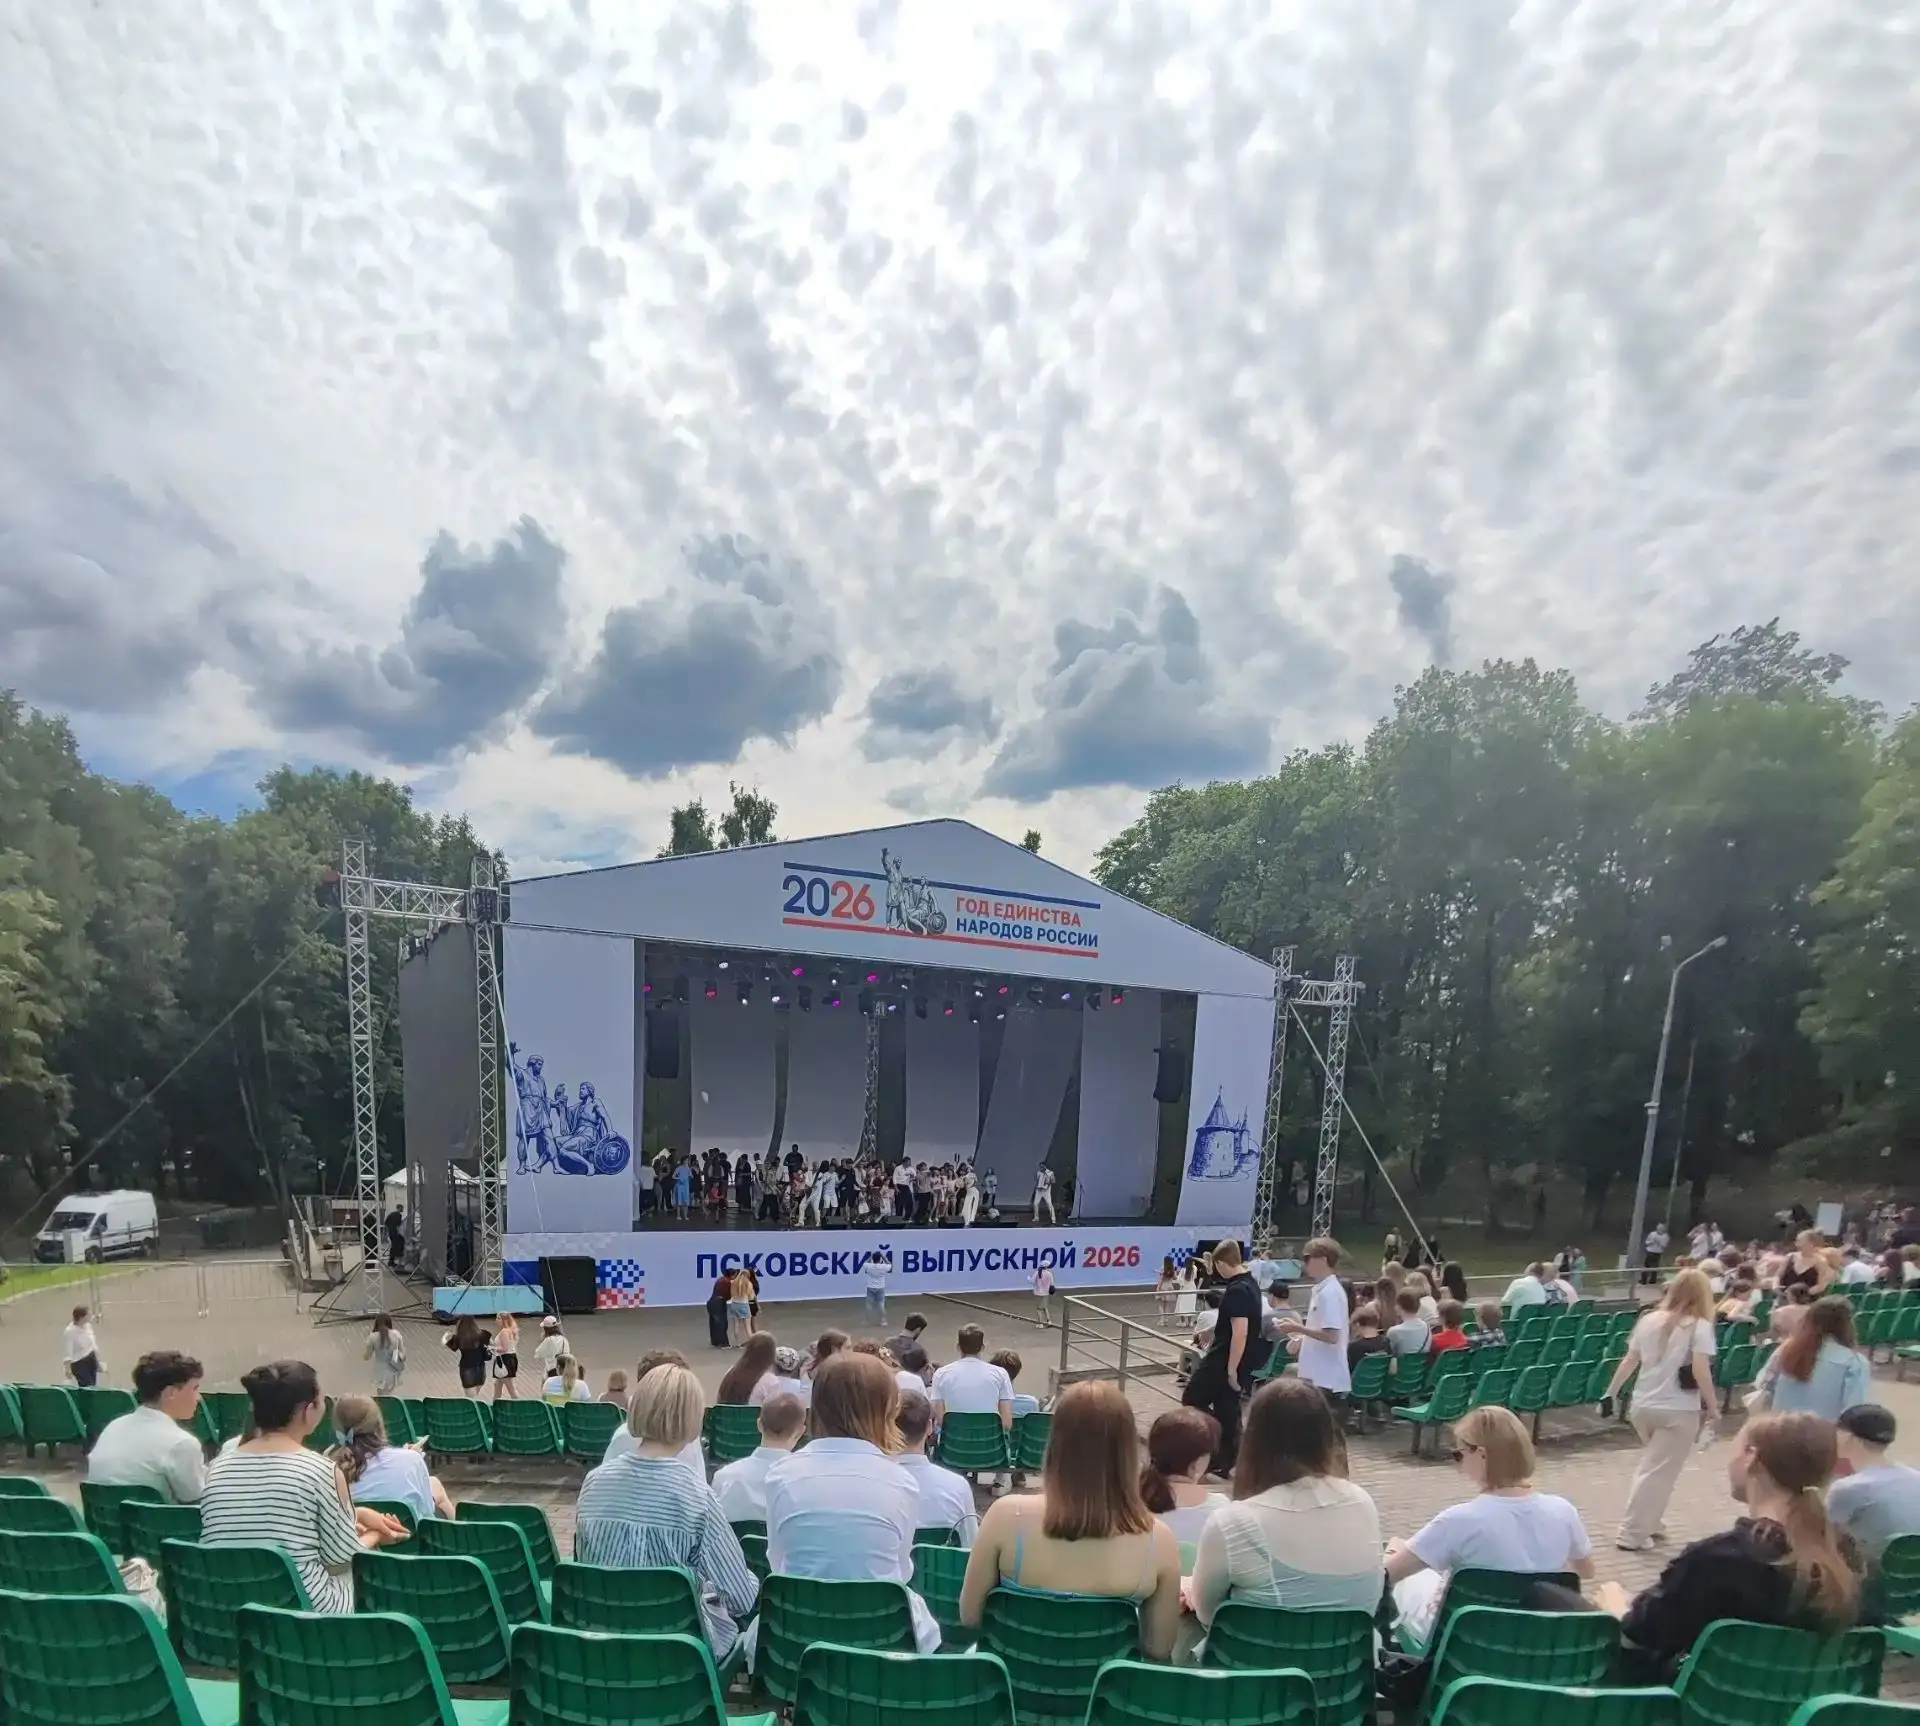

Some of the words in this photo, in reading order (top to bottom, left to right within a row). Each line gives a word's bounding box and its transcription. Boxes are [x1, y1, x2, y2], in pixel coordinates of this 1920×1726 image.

[782, 874, 875, 921] 2026
[956, 897, 989, 918] ГОД
[994, 903, 1081, 927] ЕДИНСТВА
[956, 917, 1033, 939] НАРОДОВ
[1036, 928, 1098, 948] РОССИИ
[902, 1240, 1077, 1273] ВЫПУСКНОЙ
[1082, 1246, 1141, 1268] 2026
